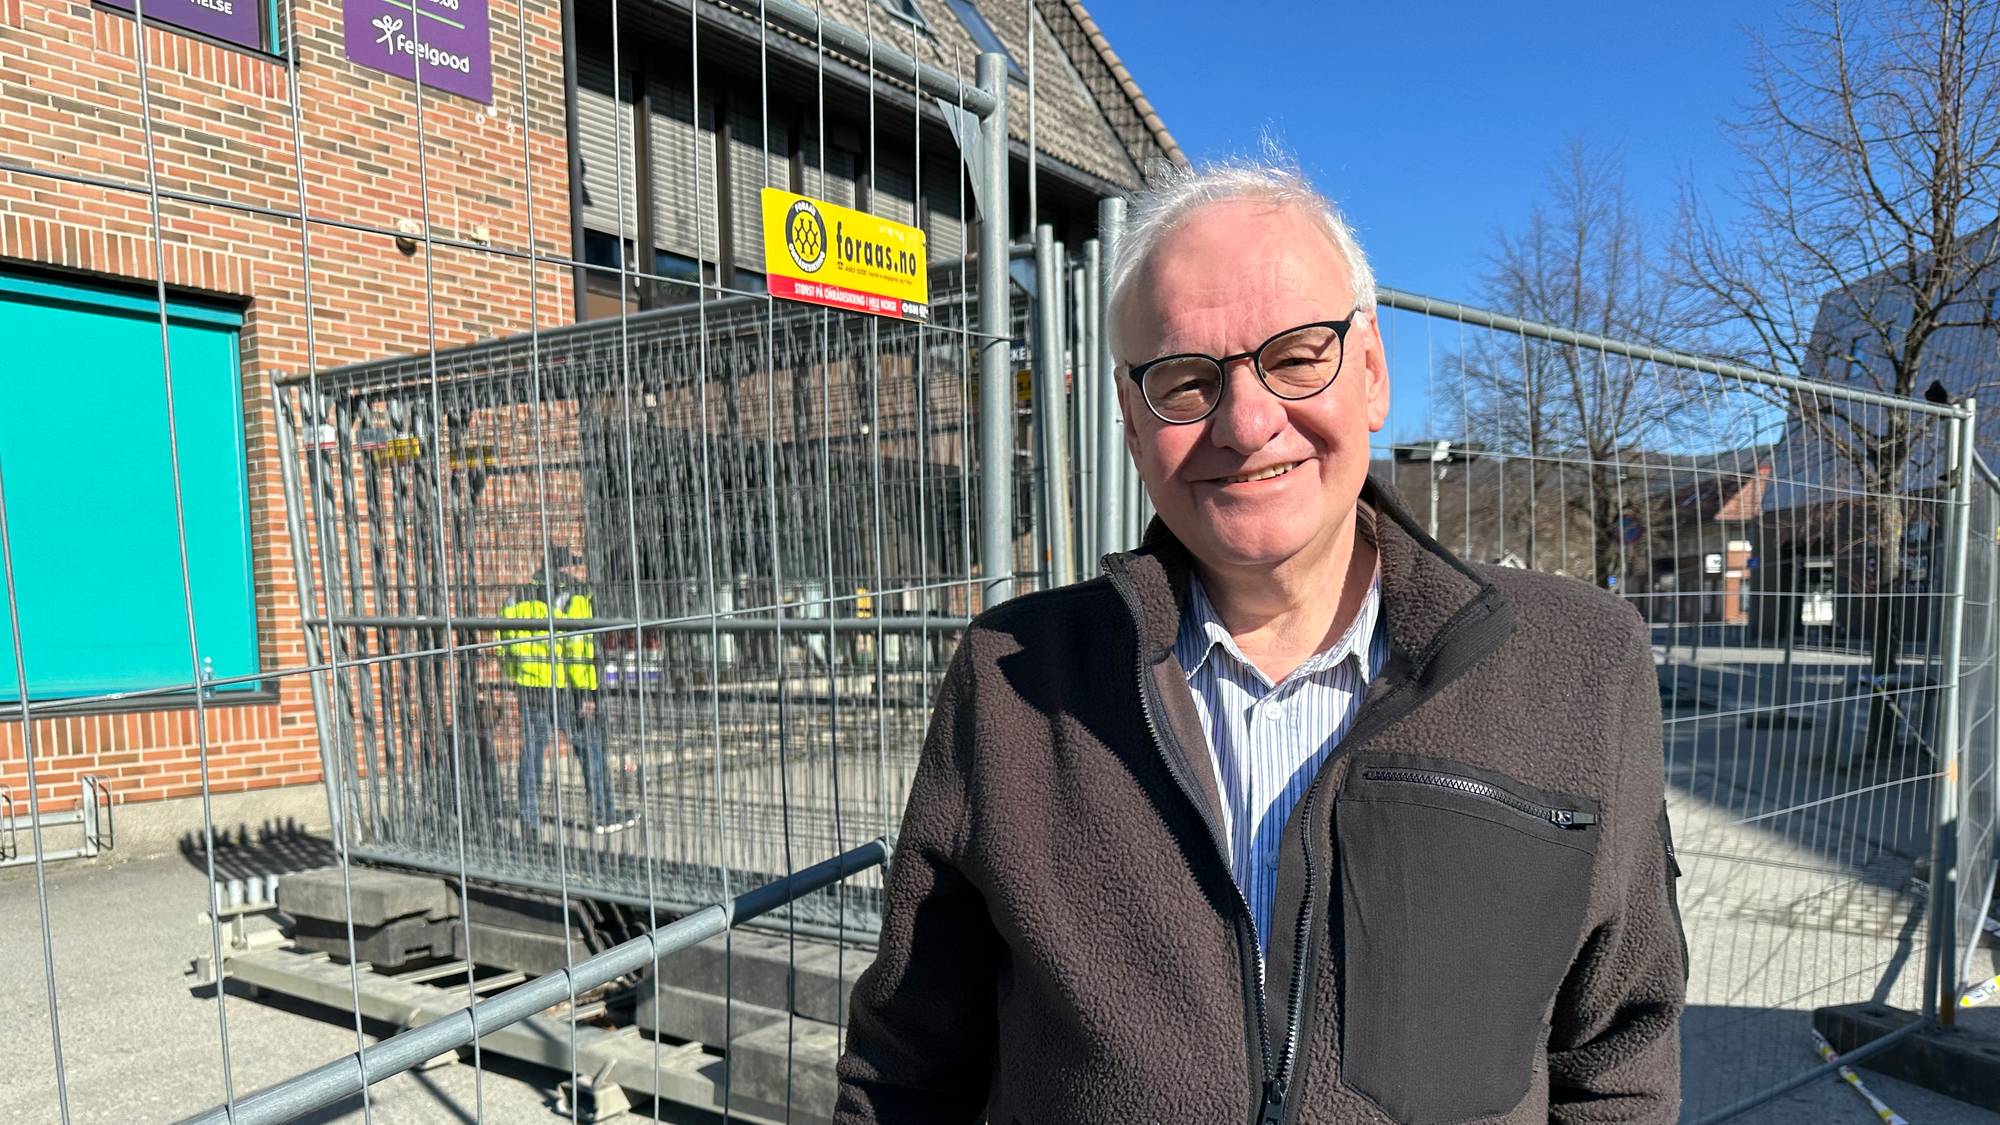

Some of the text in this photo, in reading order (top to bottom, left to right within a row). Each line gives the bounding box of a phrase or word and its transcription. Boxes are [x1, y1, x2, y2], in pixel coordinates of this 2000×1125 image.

[397, 34, 470, 73] feelgood
[836, 221, 916, 277] foraas.no
[794, 282, 815, 297] STØRST
[816, 284, 824, 299] PÅ
[824, 286, 865, 306] OMRÅDESIKRING
[880, 298, 897, 312] NORGE
